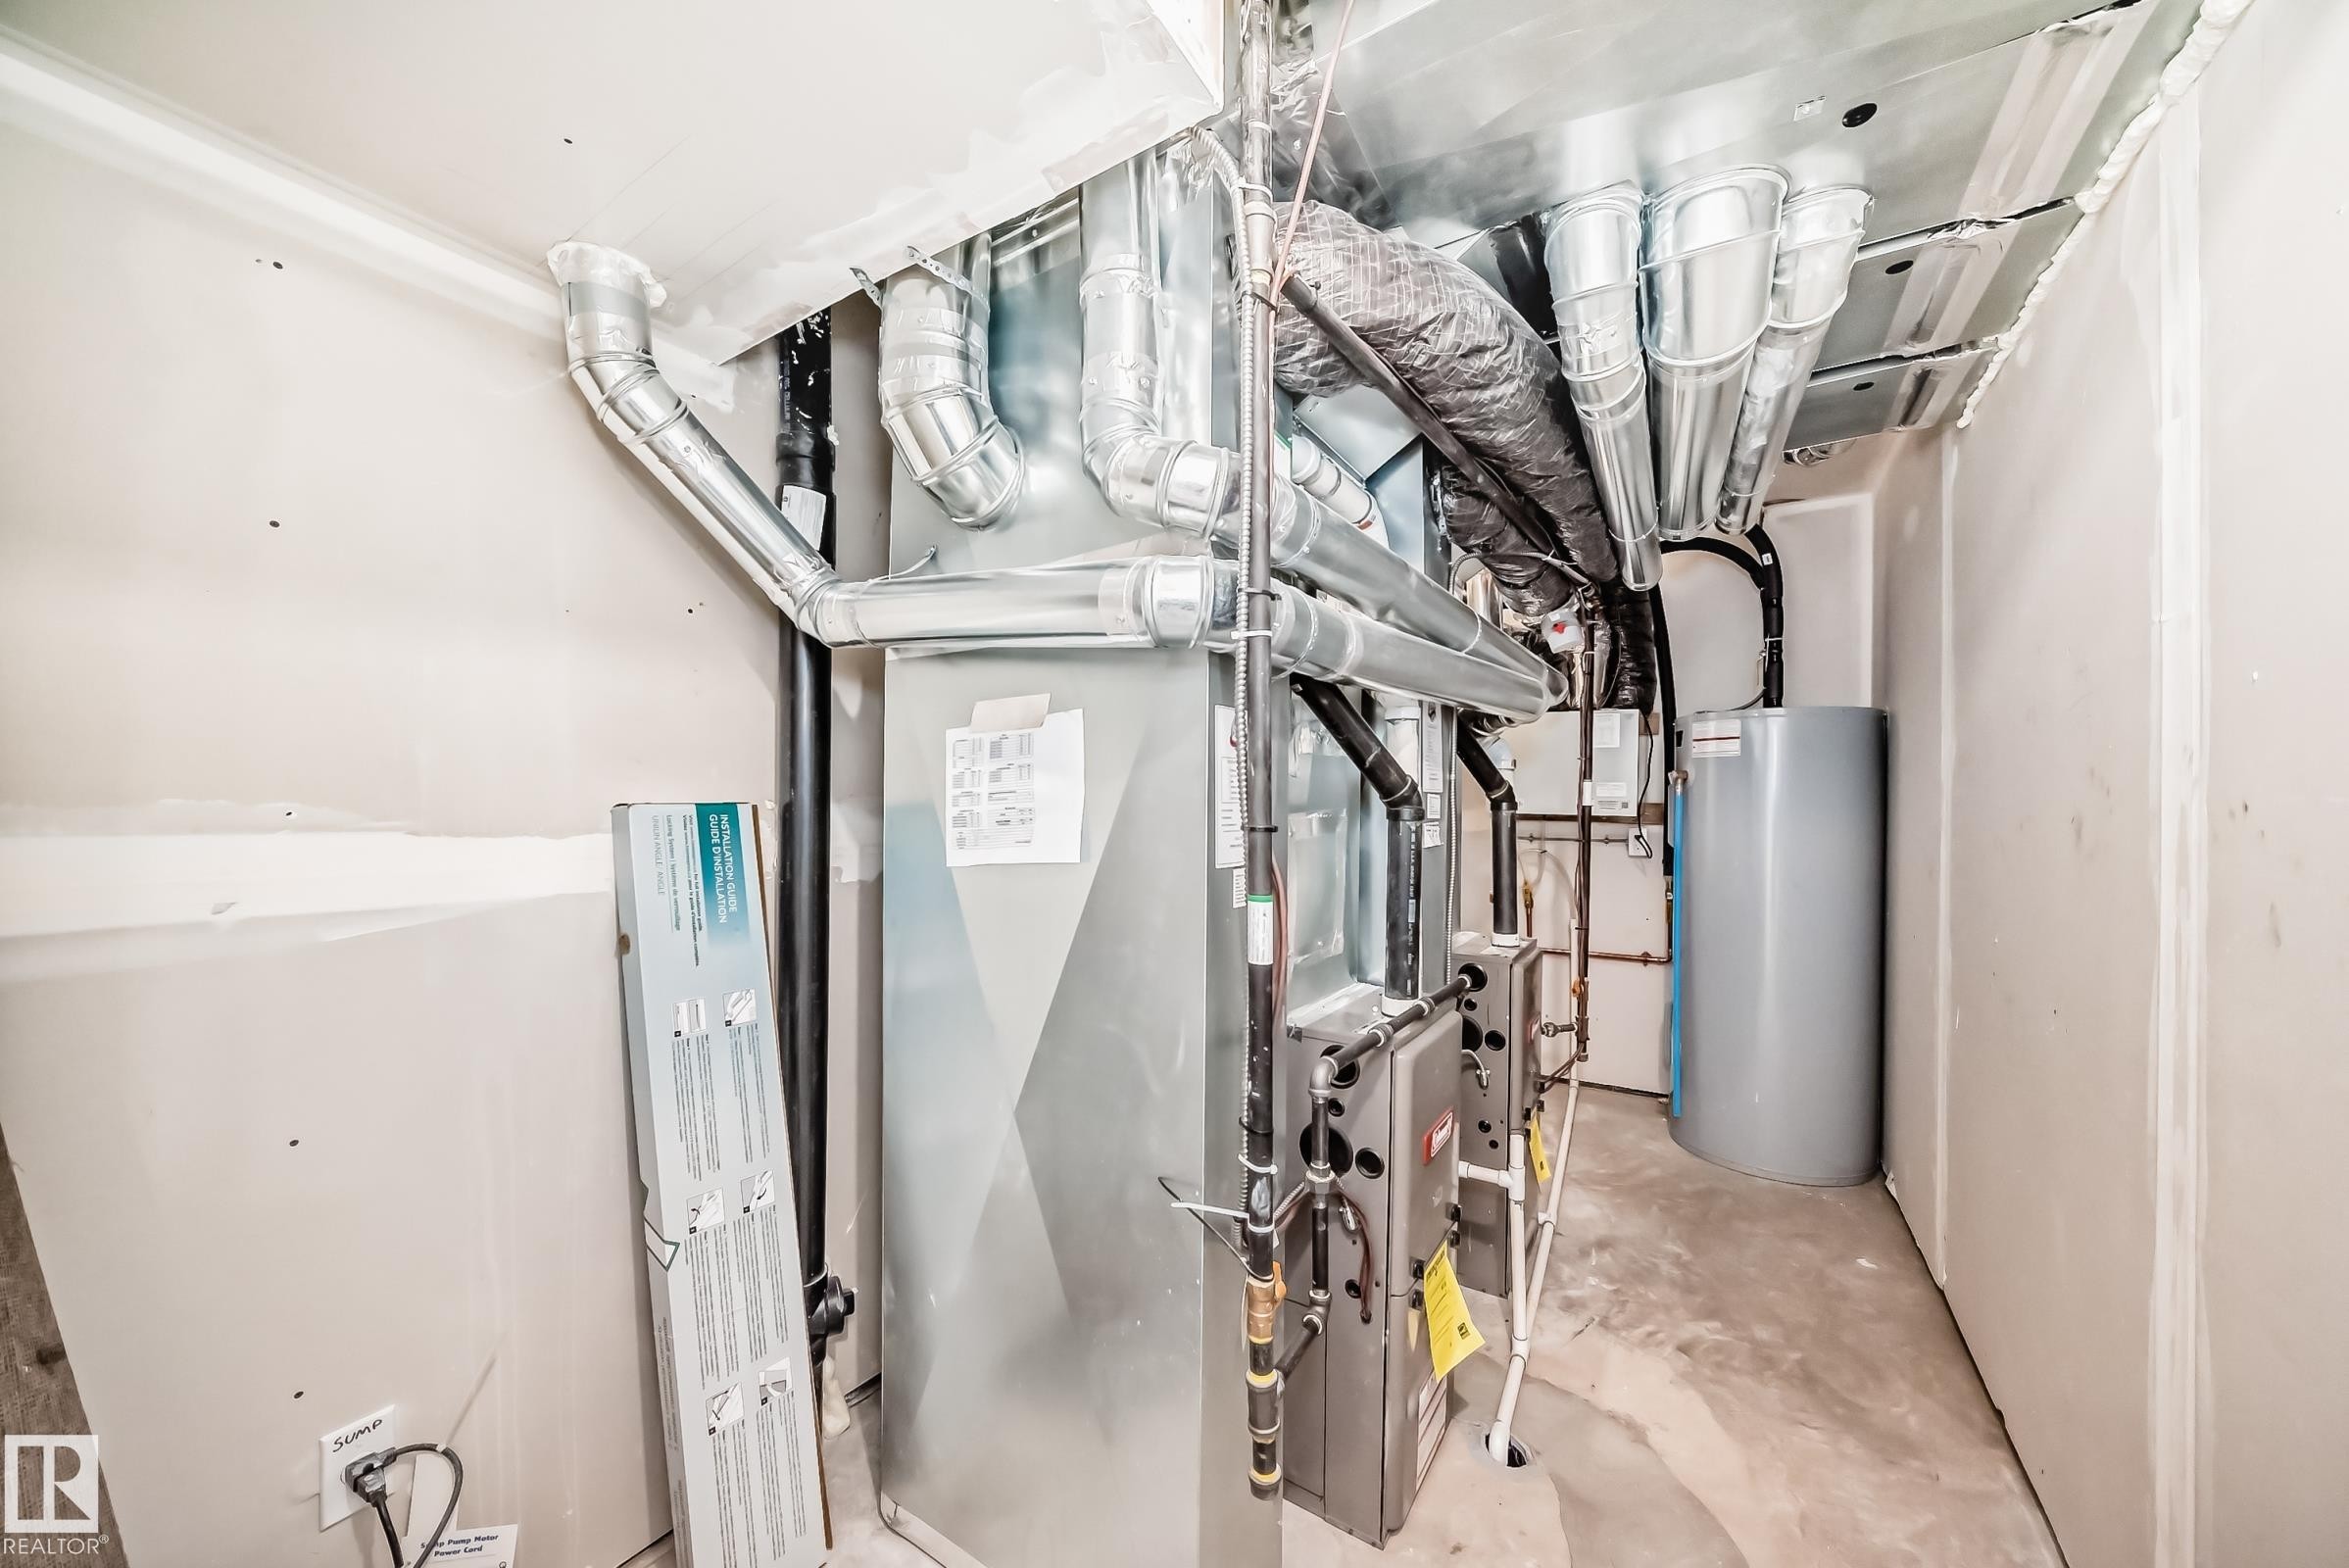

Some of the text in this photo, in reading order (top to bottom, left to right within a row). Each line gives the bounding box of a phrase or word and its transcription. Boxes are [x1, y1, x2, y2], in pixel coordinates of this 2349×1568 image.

[709, 813, 727, 923] GUIDE D'INSTALLATION
[719, 814, 738, 912] INSTALLATION GUIDE
[332, 1419, 382, 1452] SUMP
[434, 1544, 483, 1557] Power Cord
